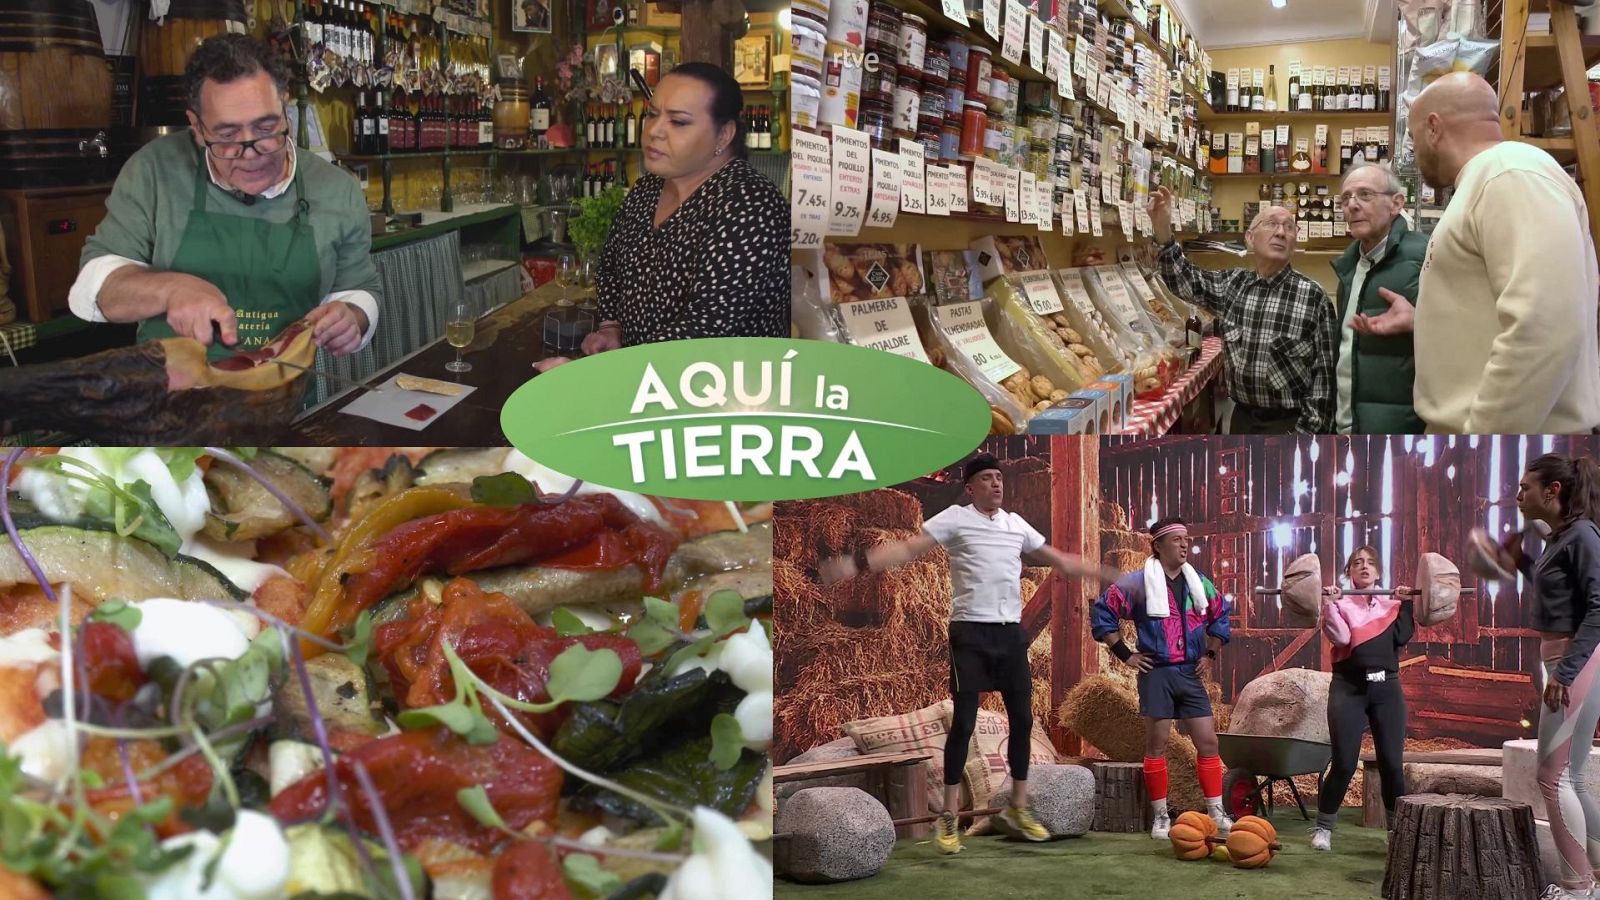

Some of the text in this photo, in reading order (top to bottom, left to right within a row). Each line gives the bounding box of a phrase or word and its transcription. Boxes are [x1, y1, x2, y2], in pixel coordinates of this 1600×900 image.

[796, 139, 828, 152] PIMIENTOS
[836, 135, 868, 149] PIMIENTOS
[793, 152, 831, 165] DEL PIQUILLO
[846, 150, 857, 159] DEL
[901, 147, 923, 158] PIMIENTOS
[839, 161, 865, 173] PIQUILLO
[875, 158, 899, 169] PIMIENTOS
[883, 171, 892, 179] DEL
[903, 169, 921, 179] PIQUILLO
[928, 171, 949, 180] PIMIENTOS
[877, 182, 898, 191] PIQUILLO
[797, 189, 826, 207] 7.45€
[851, 299, 898, 316] PALMERAS
[950, 306, 972, 318] PASTAS
[235, 309, 279, 320] Antigua
[874, 320, 888, 332] DE
[945, 319, 985, 335] ALMENDRADAS
